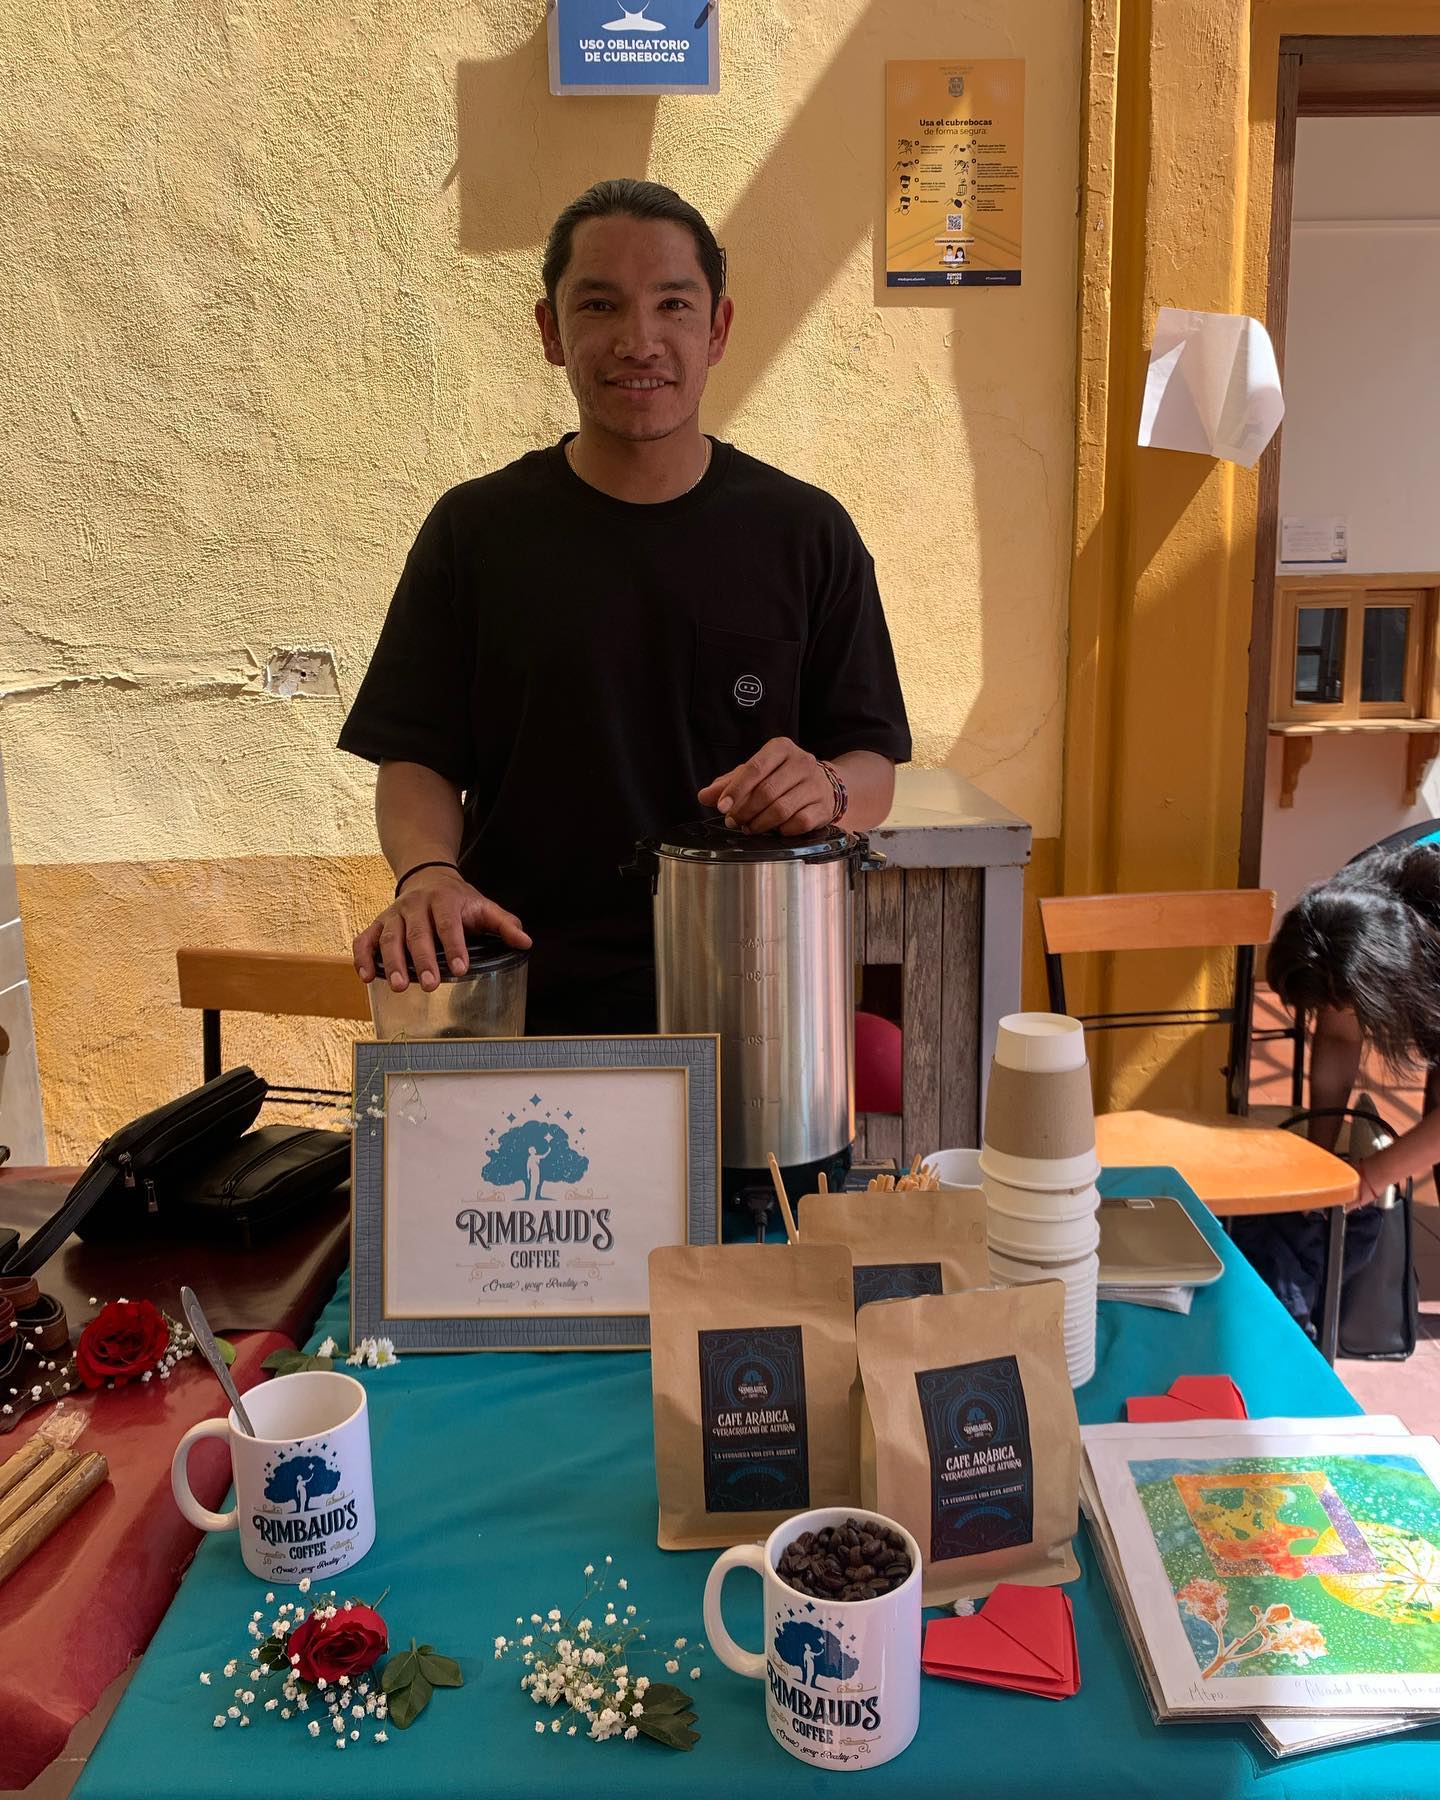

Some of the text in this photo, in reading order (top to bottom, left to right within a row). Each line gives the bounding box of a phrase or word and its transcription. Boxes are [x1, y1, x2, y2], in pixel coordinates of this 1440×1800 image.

[579, 39, 690, 50] USO OBLIGATORIO
[584, 51, 685, 63] DE CUBREBOCAS
[919, 119, 935, 127] Usa
[945, 118, 993, 126] cubrebocas
[960, 128, 987, 136] segura
[455, 1208, 615, 1251] RIMBAUD'S
[510, 1250, 561, 1269] COFFEE
[482, 1277, 589, 1293] Create your Reality
[718, 1409, 789, 1426] CAFE ARÁBICA
[713, 1426, 760, 1437] VERACRUZANO
[946, 1445, 1015, 1470] CAFE ARÁBICA
[941, 1467, 988, 1482] VERACRUZANO
[252, 1498, 358, 1547] RIMBAUD'S
[289, 1541, 327, 1560] COFFEE
[767, 1659, 881, 1731] RIMBAUD'S
[792, 1717, 834, 1745] COFFEE
[800, 1745, 819, 1757] your
[820, 1749, 859, 1763] Reality
